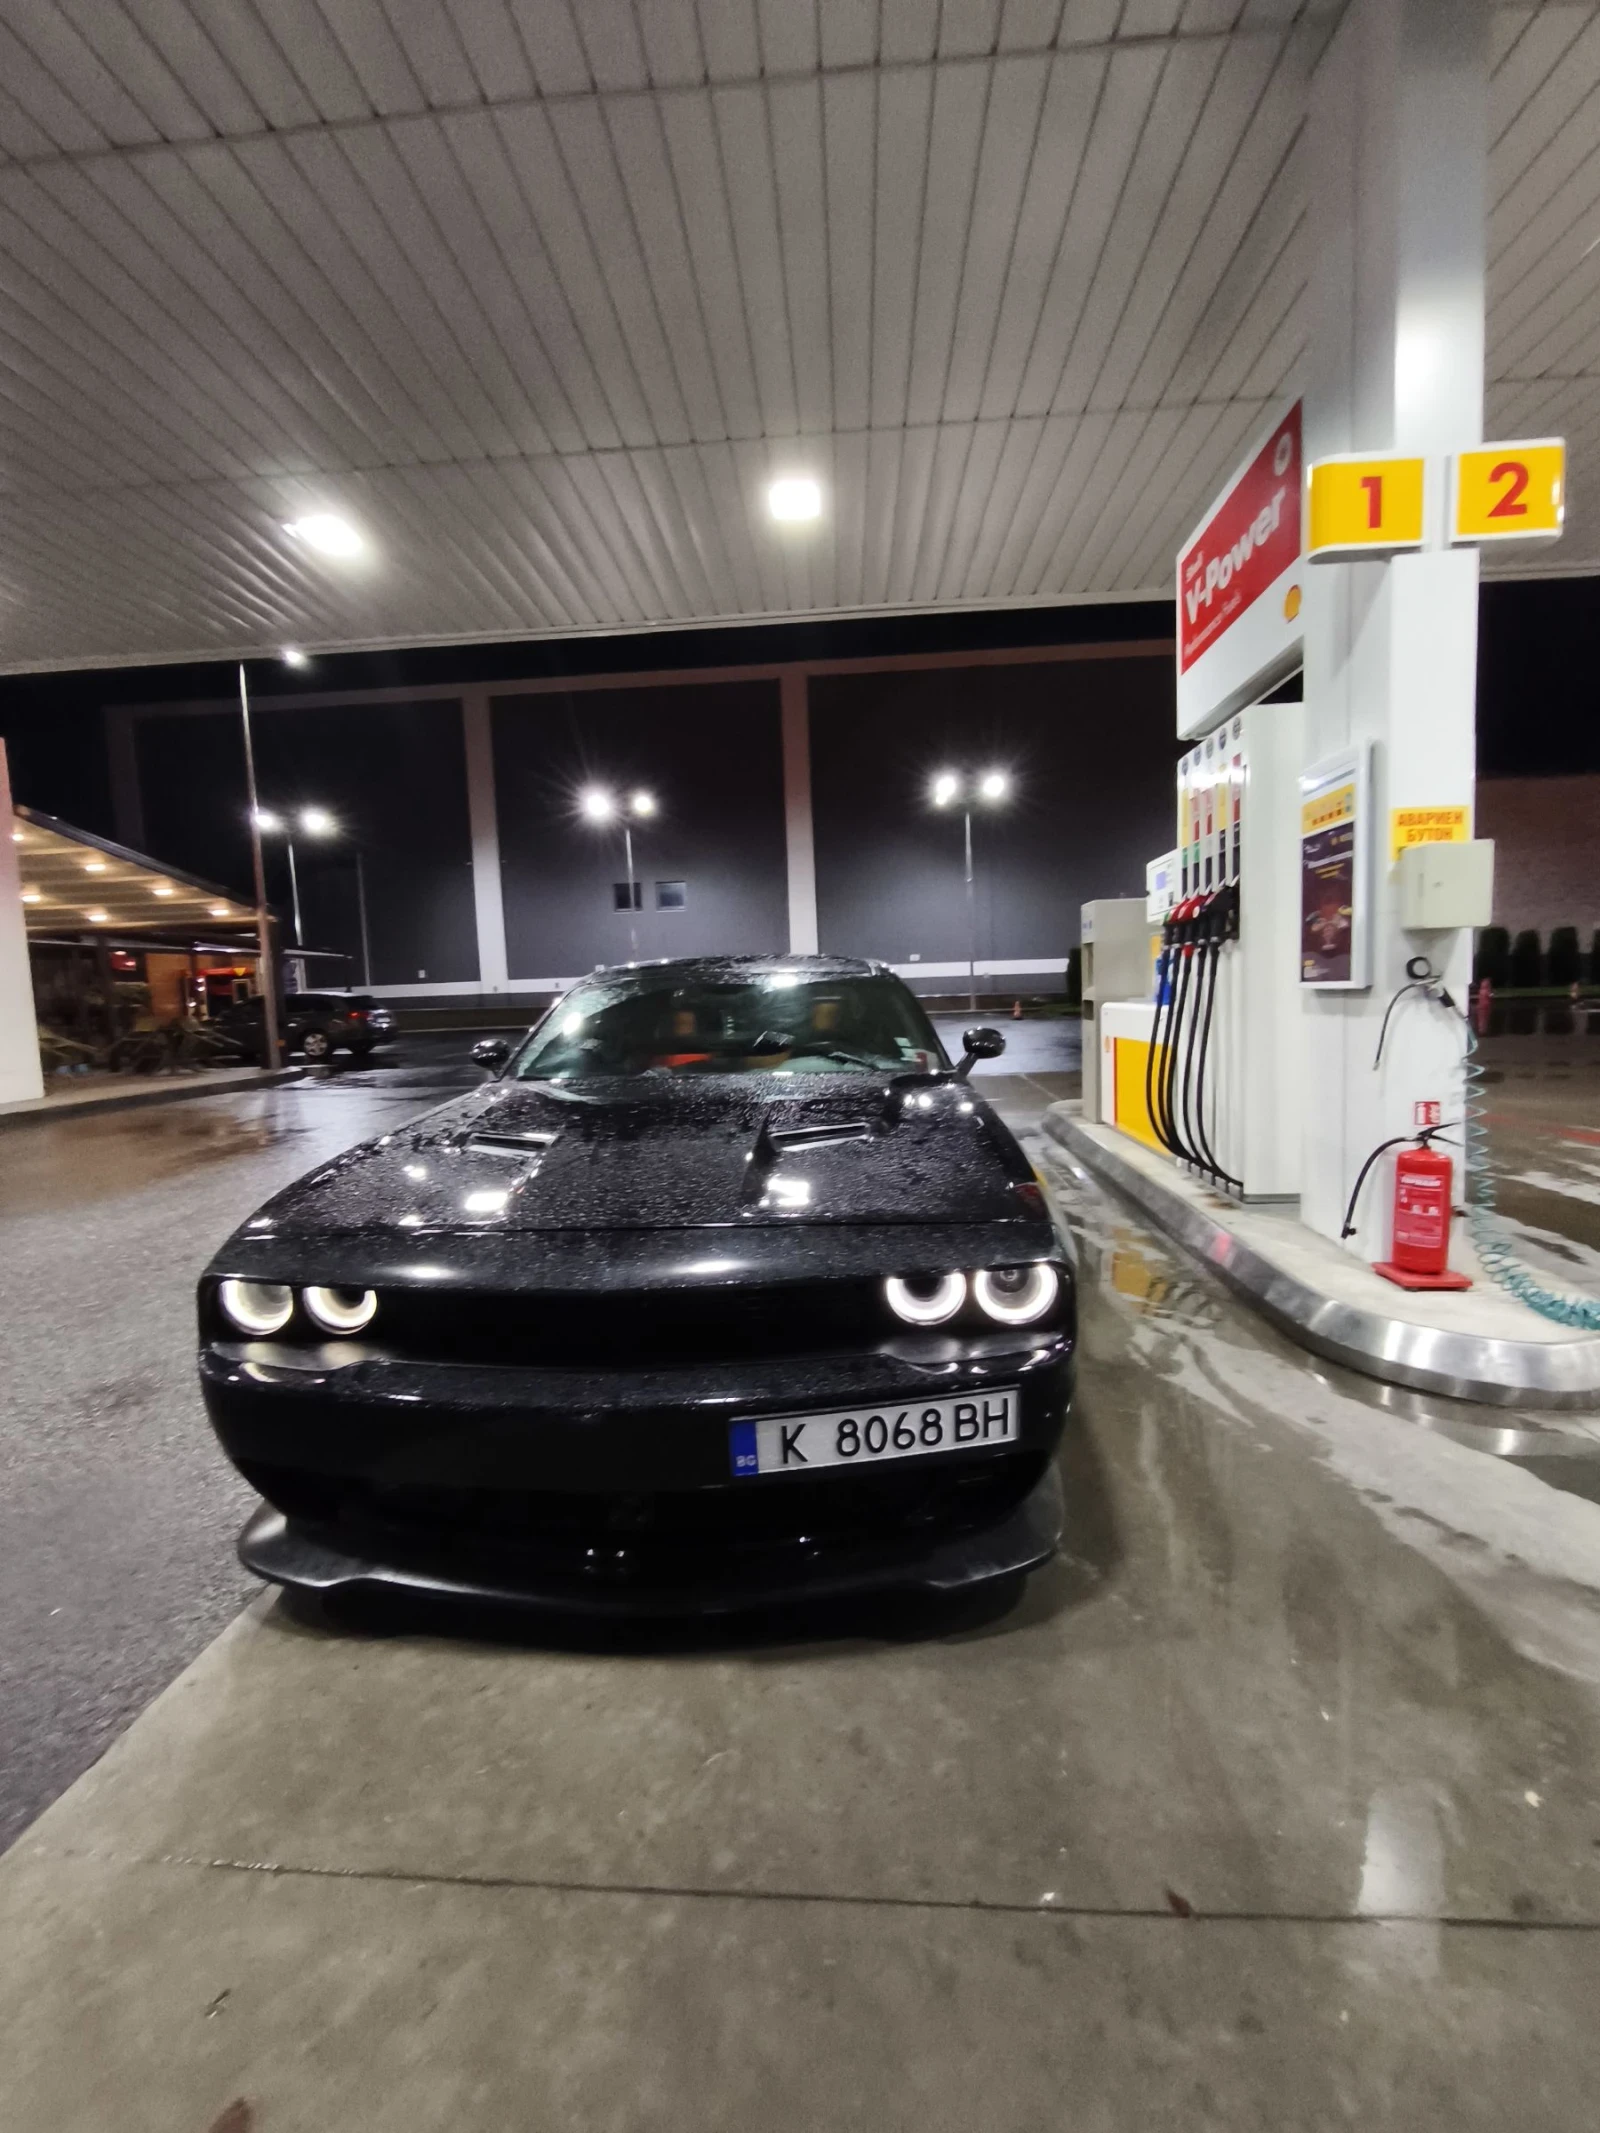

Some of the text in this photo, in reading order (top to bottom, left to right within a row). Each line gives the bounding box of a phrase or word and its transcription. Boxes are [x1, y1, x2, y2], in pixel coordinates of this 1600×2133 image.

[1360, 476, 1383, 529] 1
[1487, 462, 1528, 518] 2
[1185, 486, 1287, 624] V-Power
[781, 1423, 808, 1464] K
